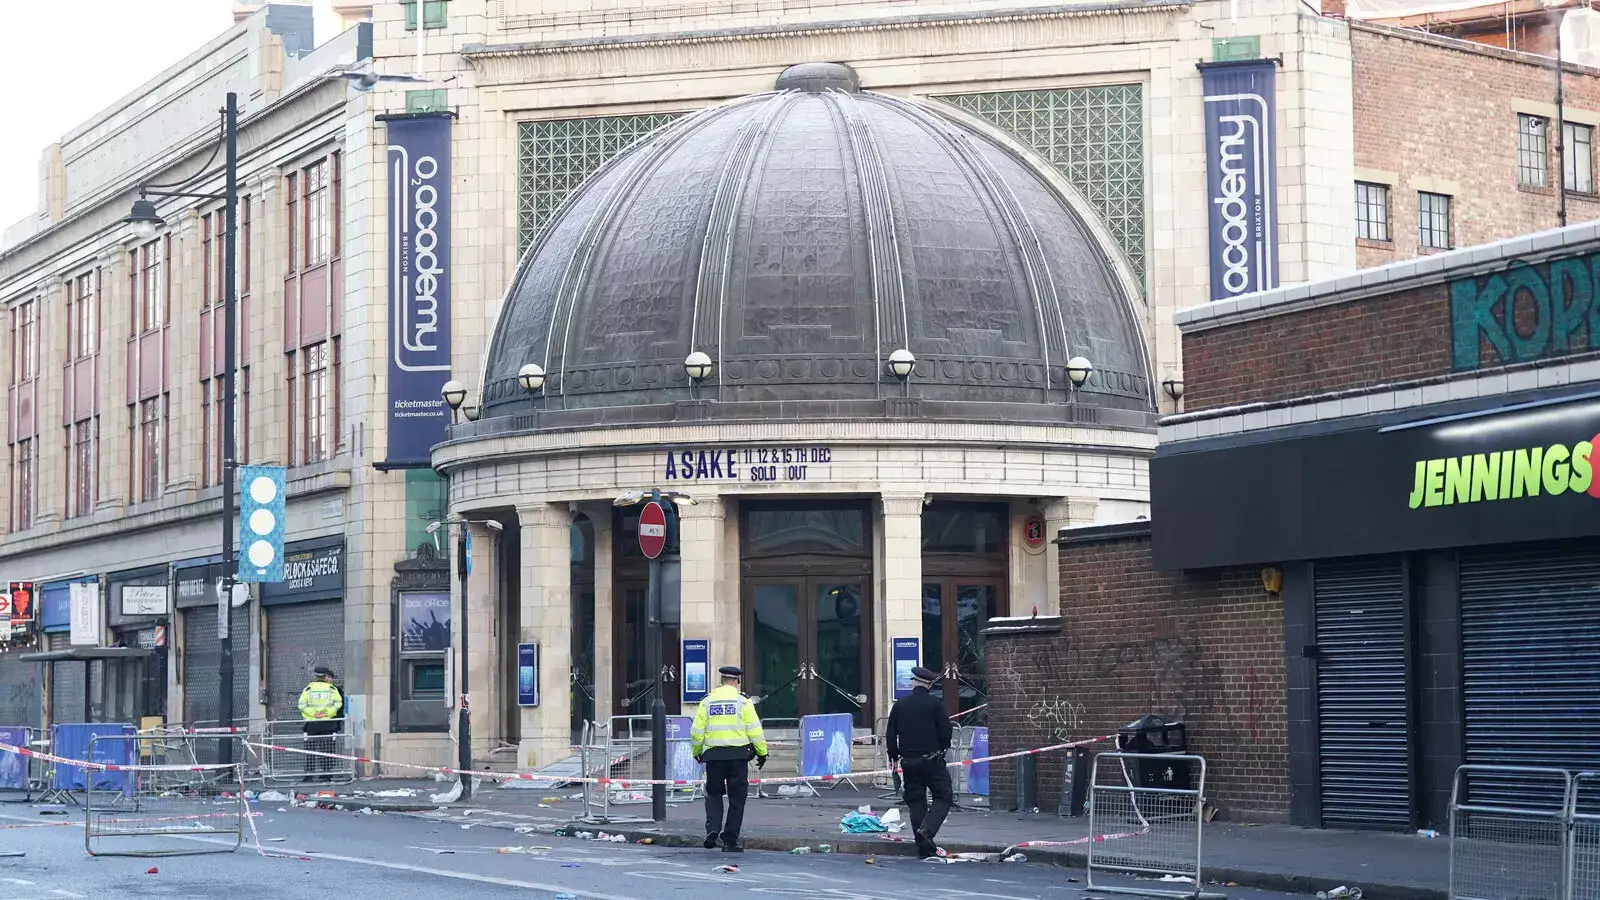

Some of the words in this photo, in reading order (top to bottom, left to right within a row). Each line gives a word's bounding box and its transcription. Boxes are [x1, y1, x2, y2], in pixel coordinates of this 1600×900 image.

[1214, 114, 1249, 293] academy
[394, 399, 444, 408] ticketmaster
[665, 449, 738, 480] ASAKE
[758, 449, 768, 463] 12
[771, 449, 780, 463] &
[811, 447, 832, 463] DEC
[750, 465, 777, 482] SOLD
[788, 465, 808, 481] OUT
[1408, 441, 1593, 510] JENNINGS
